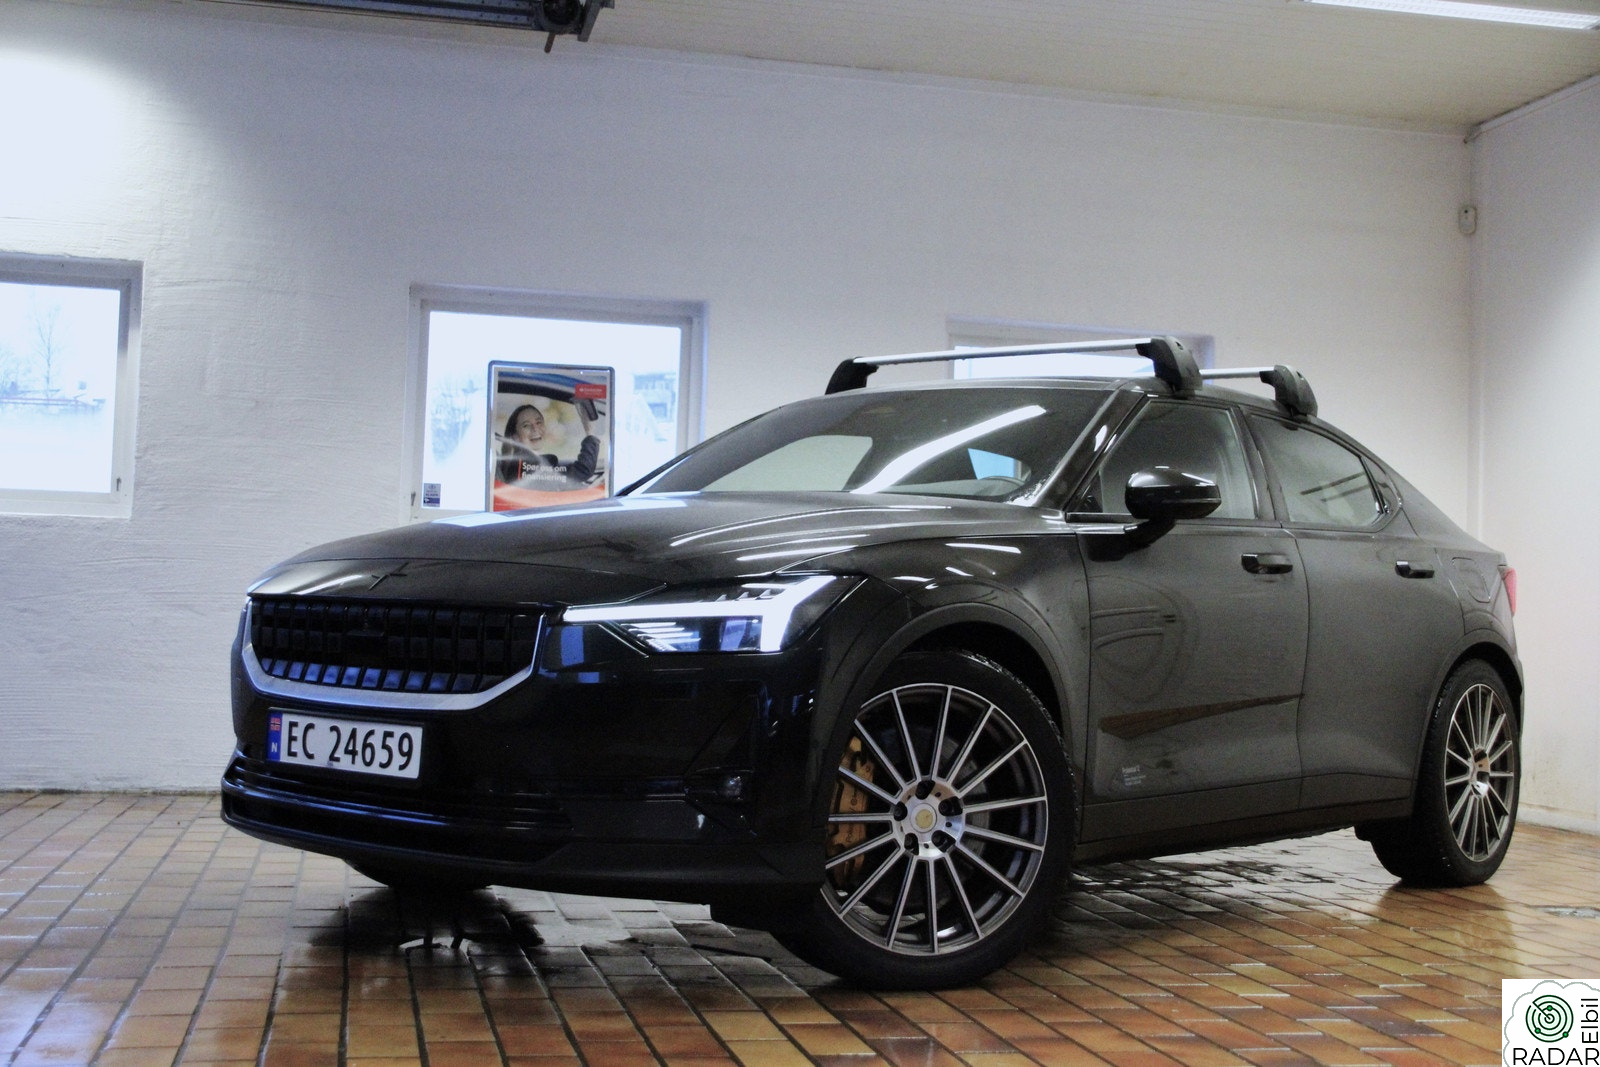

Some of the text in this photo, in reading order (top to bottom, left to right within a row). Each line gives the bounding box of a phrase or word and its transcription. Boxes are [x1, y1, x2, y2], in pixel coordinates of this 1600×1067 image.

[522, 471, 567, 483] finansiering
[271, 742, 278, 753] N
[287, 720, 414, 771] EC 24659
